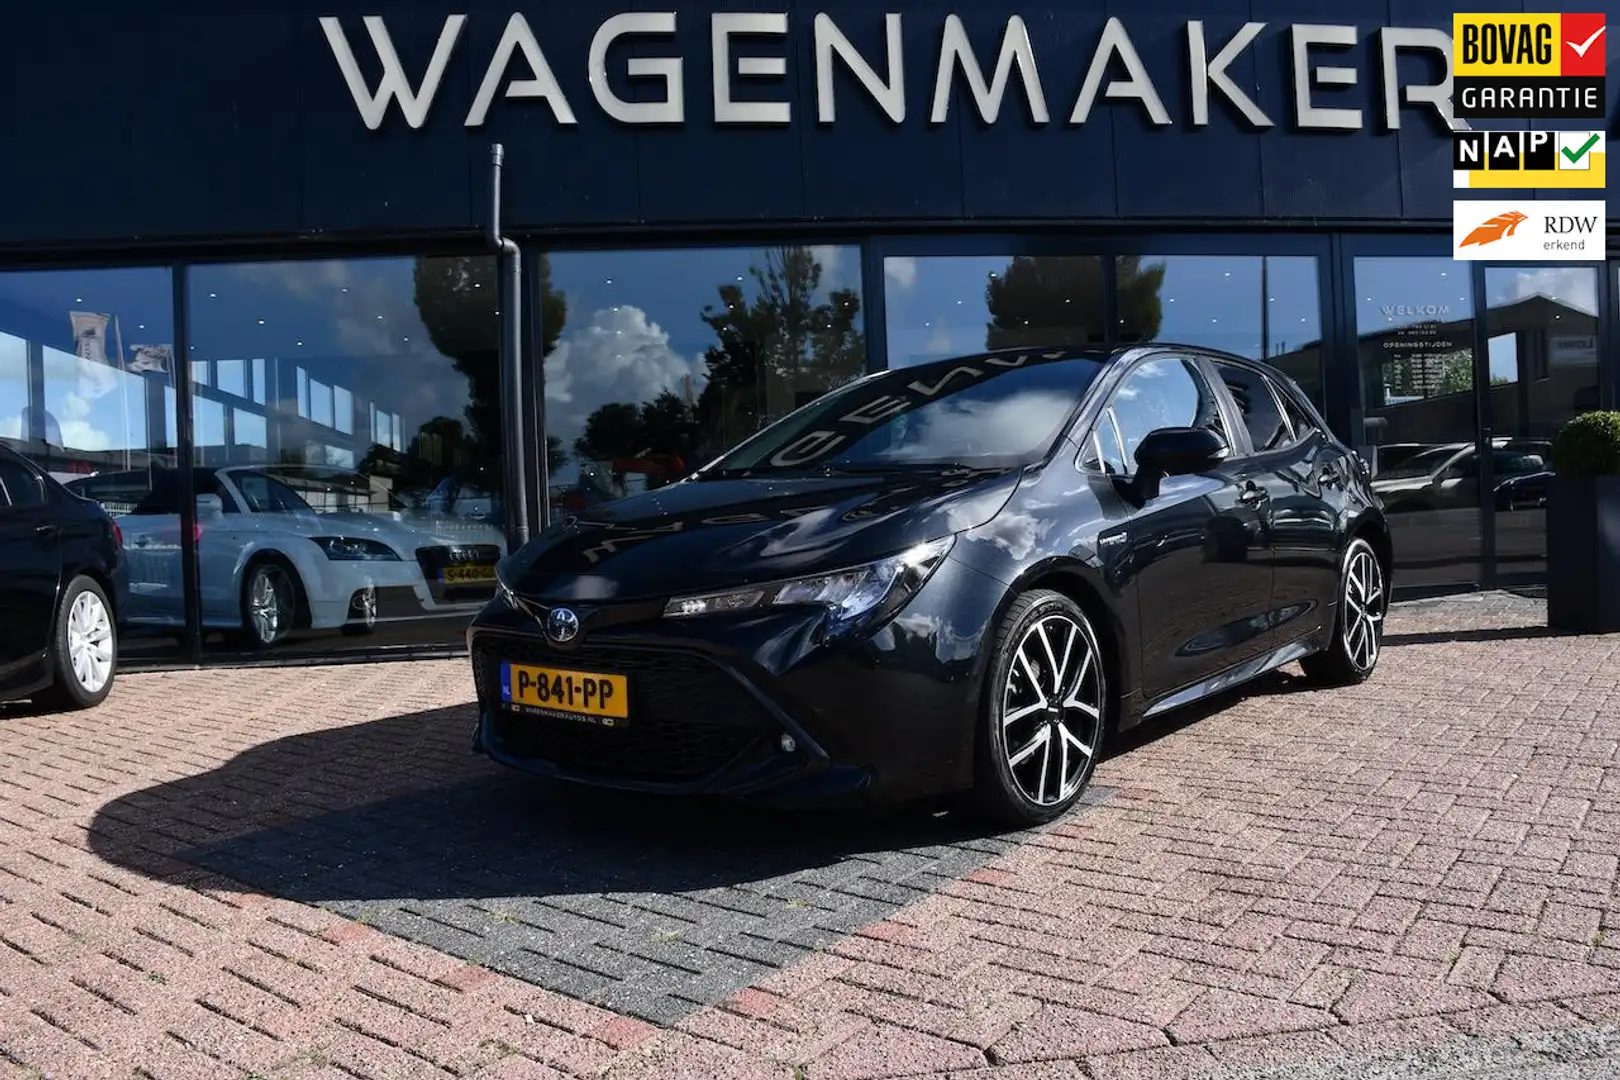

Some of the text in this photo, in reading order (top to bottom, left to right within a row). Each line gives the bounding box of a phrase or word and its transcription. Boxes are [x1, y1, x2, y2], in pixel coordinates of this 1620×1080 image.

[318, 11, 1472, 131] WAGENMAKER
[1380, 304, 1450, 316] WELKOM
[518, 670, 613, 709] P-841-PP
